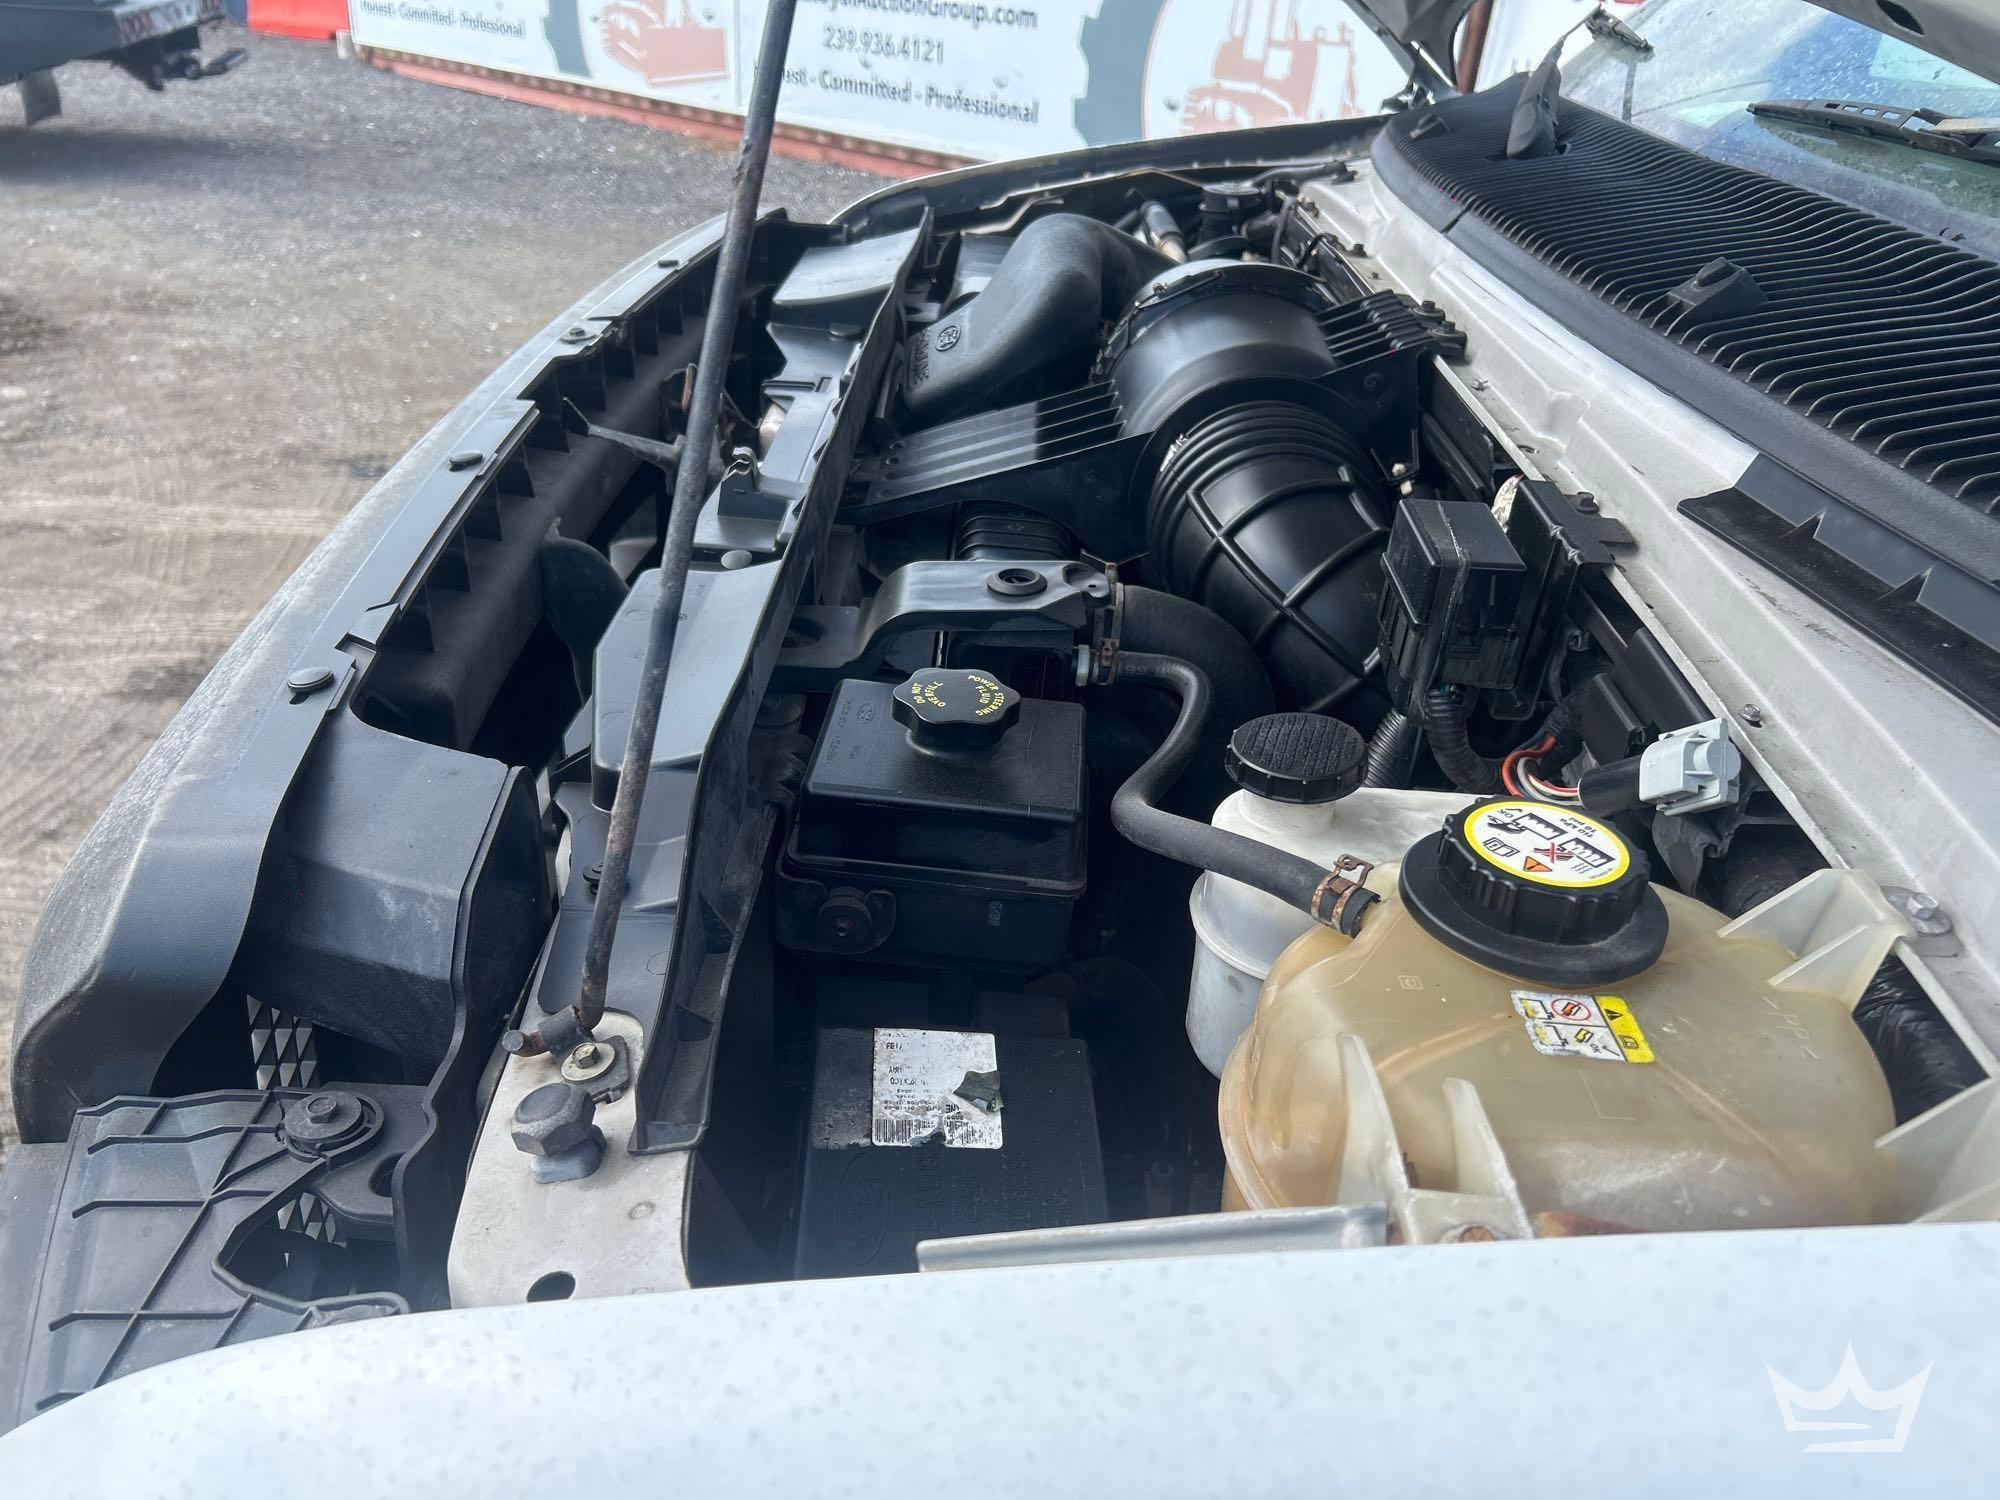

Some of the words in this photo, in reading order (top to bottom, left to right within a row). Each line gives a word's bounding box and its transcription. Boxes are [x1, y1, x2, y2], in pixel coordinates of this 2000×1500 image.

[399, 1, 455, 27] Committed
[459, 11, 527, 39] Professional
[803, 0, 1039, 30] yuctionGroup.com
[823, 24, 944, 63] 239.936.4121
[819, 67, 912, 103] Committed
[925, 80, 1040, 124] Professional
[924, 681, 947, 708] OVERFILL
[968, 674, 1000, 692] POWER
[975, 684, 991, 705] FLUID
[975, 691, 1005, 717] STEERING
[1496, 808, 1515, 820] OK
[1590, 1043, 1602, 1055] OK
